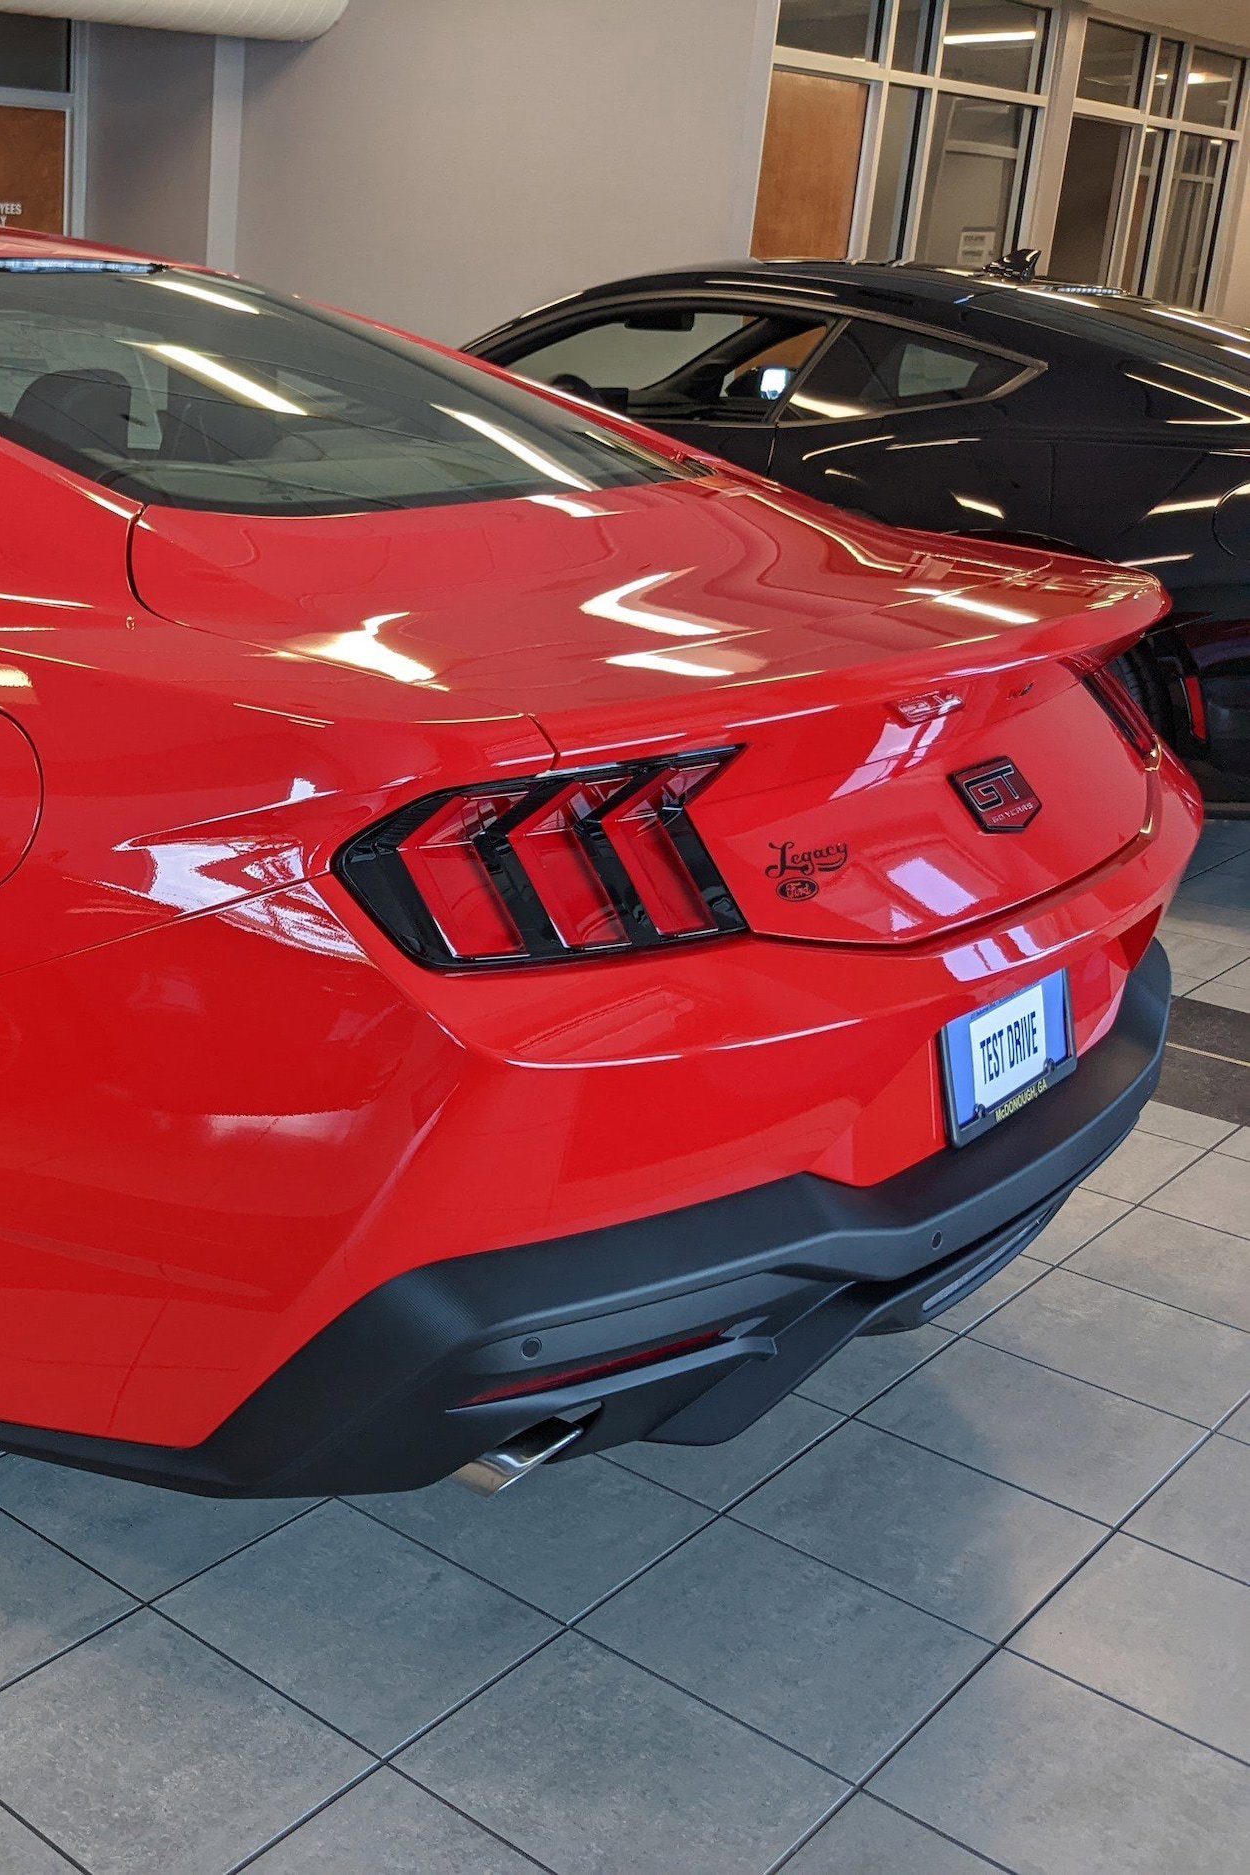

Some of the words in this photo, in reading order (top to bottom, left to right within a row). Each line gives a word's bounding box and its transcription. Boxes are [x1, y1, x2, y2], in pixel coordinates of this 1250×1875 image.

[963, 764, 1020, 812] GT
[1005, 802, 1034, 818] YEARS
[765, 841, 848, 878] Legacy
[783, 880, 815, 900] Ford
[979, 1028, 1005, 1085] TEST
[1007, 1010, 1038, 1070] DRIVE
[1037, 1079, 1048, 1094] GA
